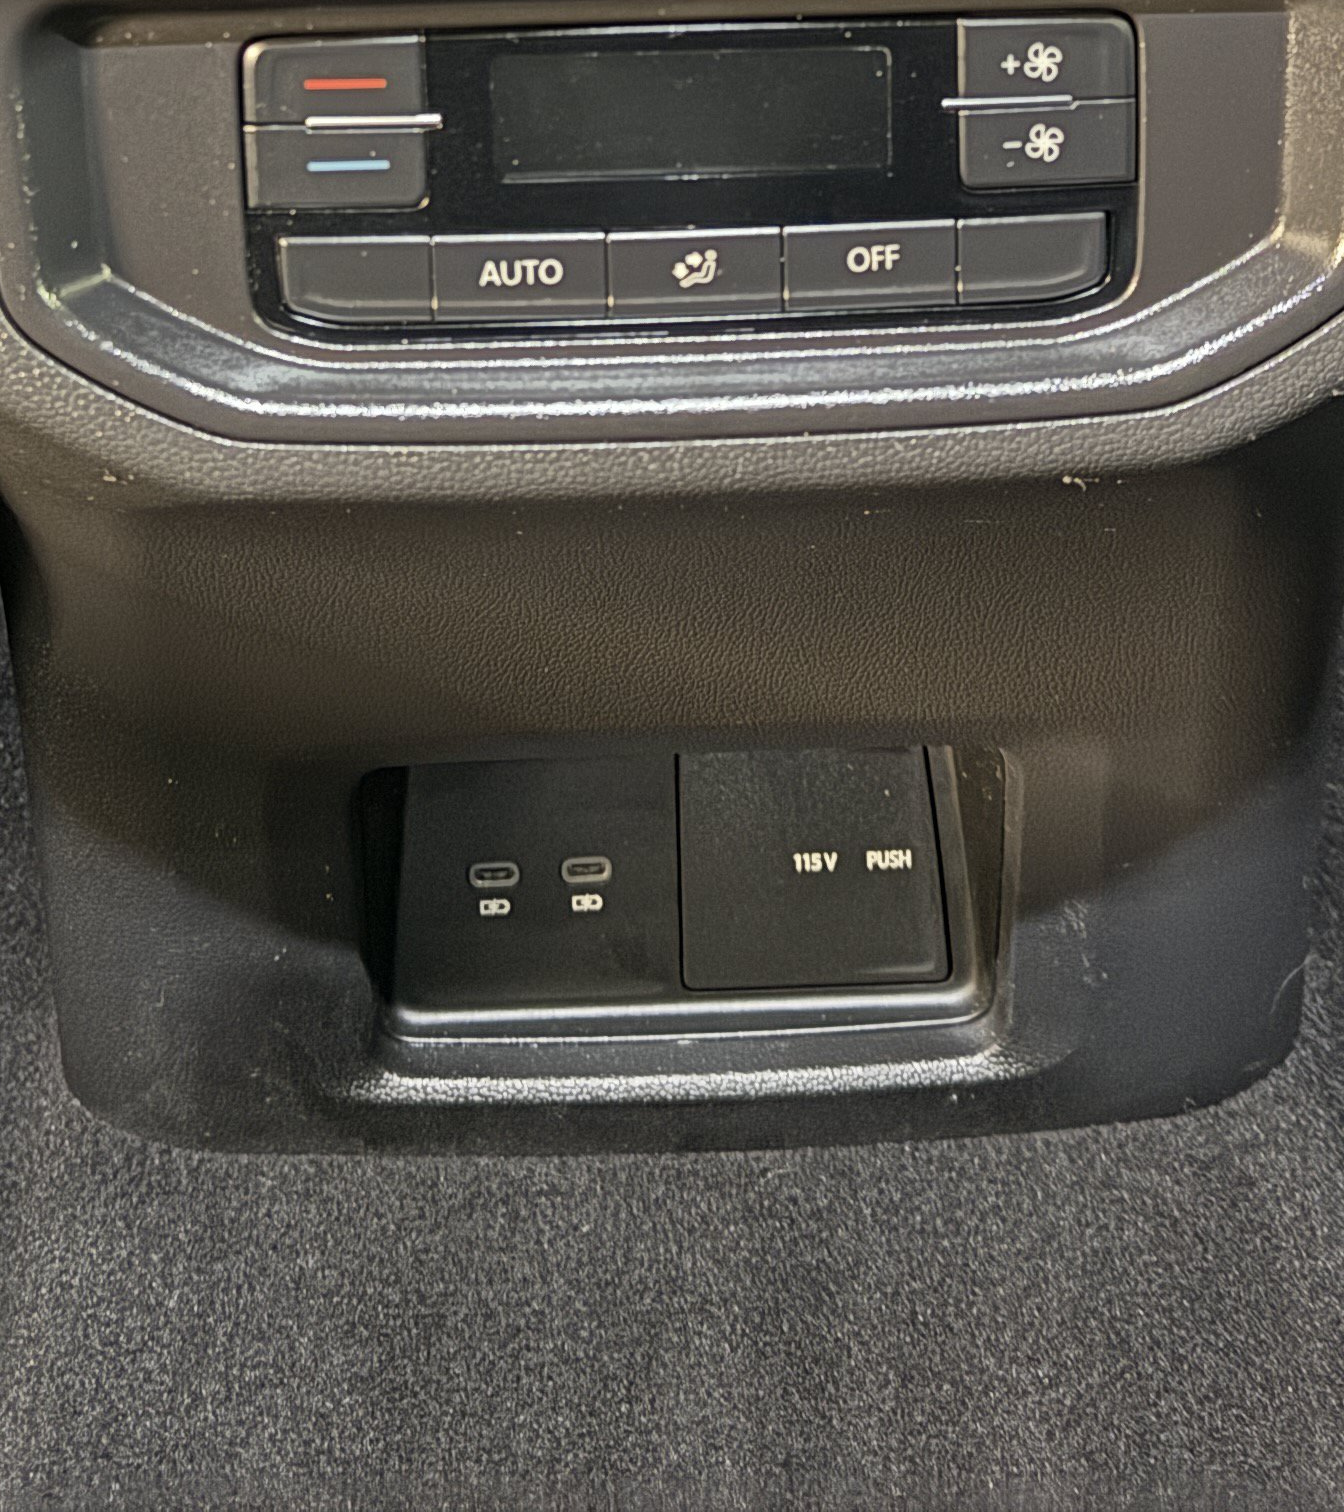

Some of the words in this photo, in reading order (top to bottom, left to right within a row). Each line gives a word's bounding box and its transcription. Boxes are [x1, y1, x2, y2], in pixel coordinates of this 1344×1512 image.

[478, 257, 564, 288] AUTO
[846, 243, 901, 273] OFF
[865, 848, 913, 872] PUSH
